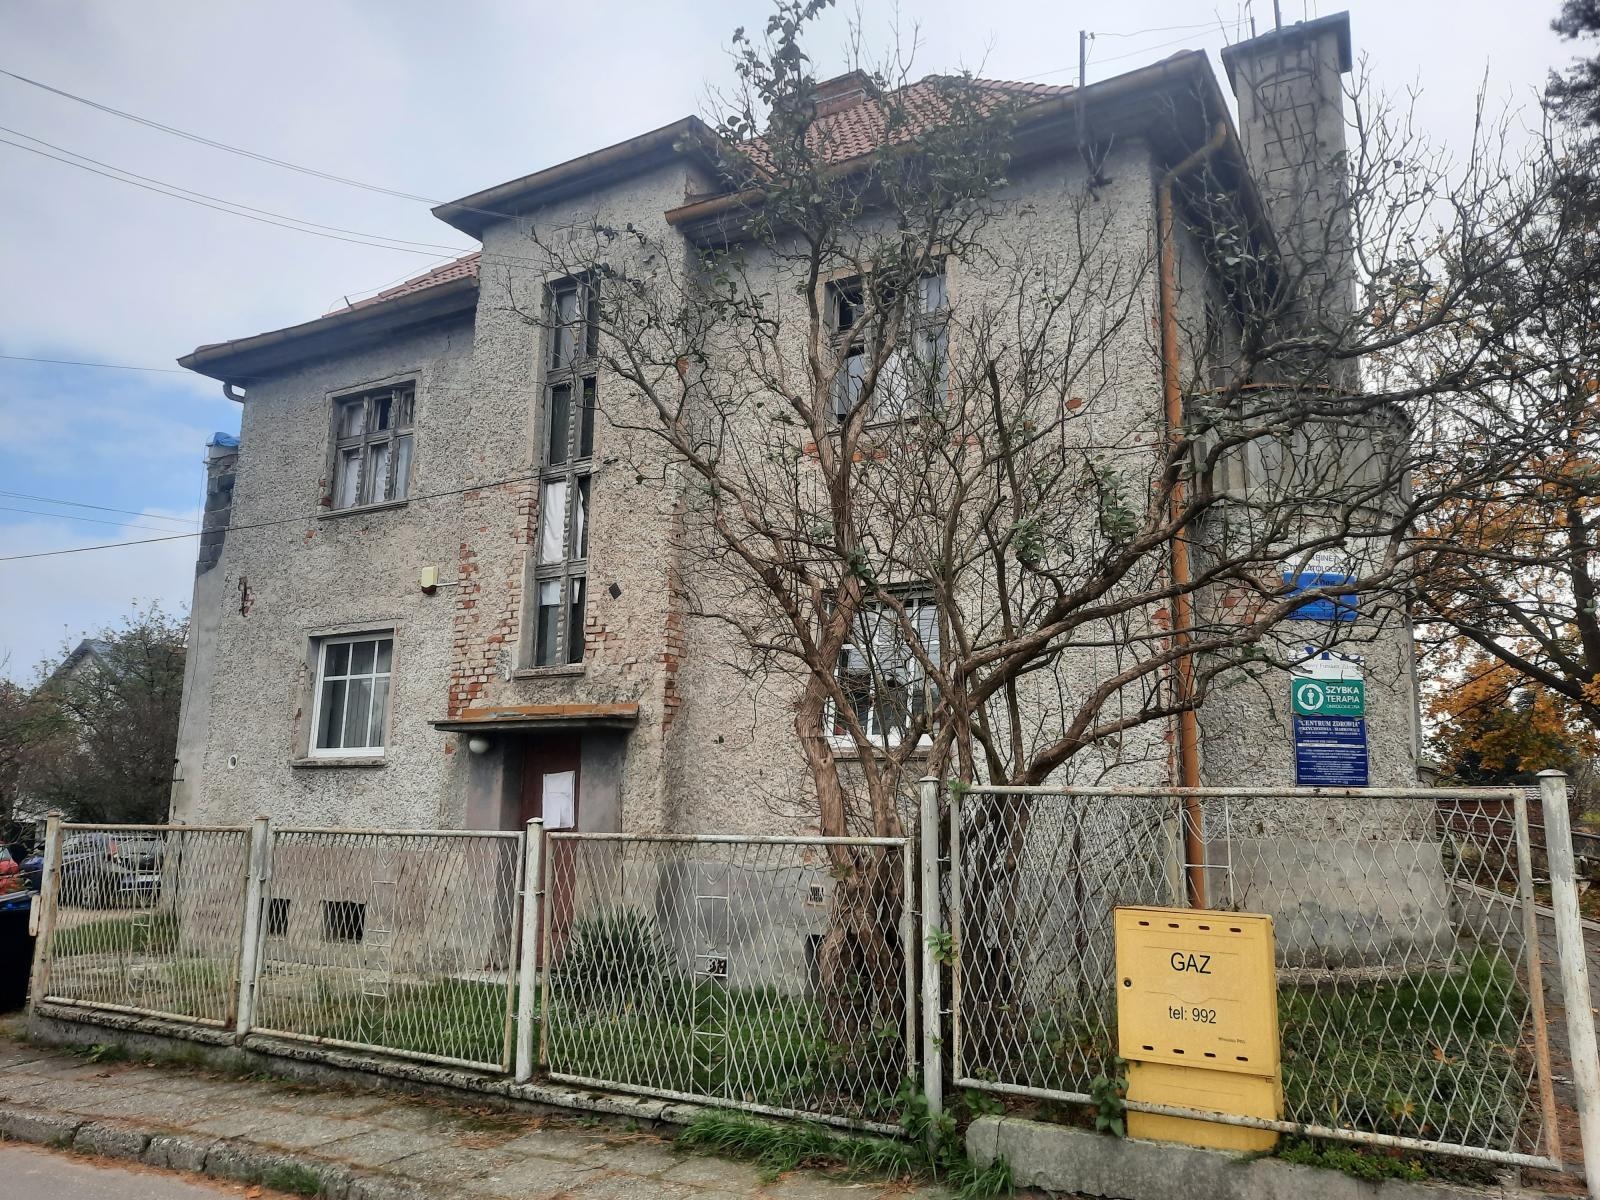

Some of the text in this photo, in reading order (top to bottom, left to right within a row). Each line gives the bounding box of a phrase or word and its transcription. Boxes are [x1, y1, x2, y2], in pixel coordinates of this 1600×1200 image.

[1325, 685, 1360, 694] SZYBKA
[1326, 695, 1360, 703] TERAPIA
[1171, 952, 1211, 974] GAZ
[1169, 1006, 1217, 1024] tel: 992
